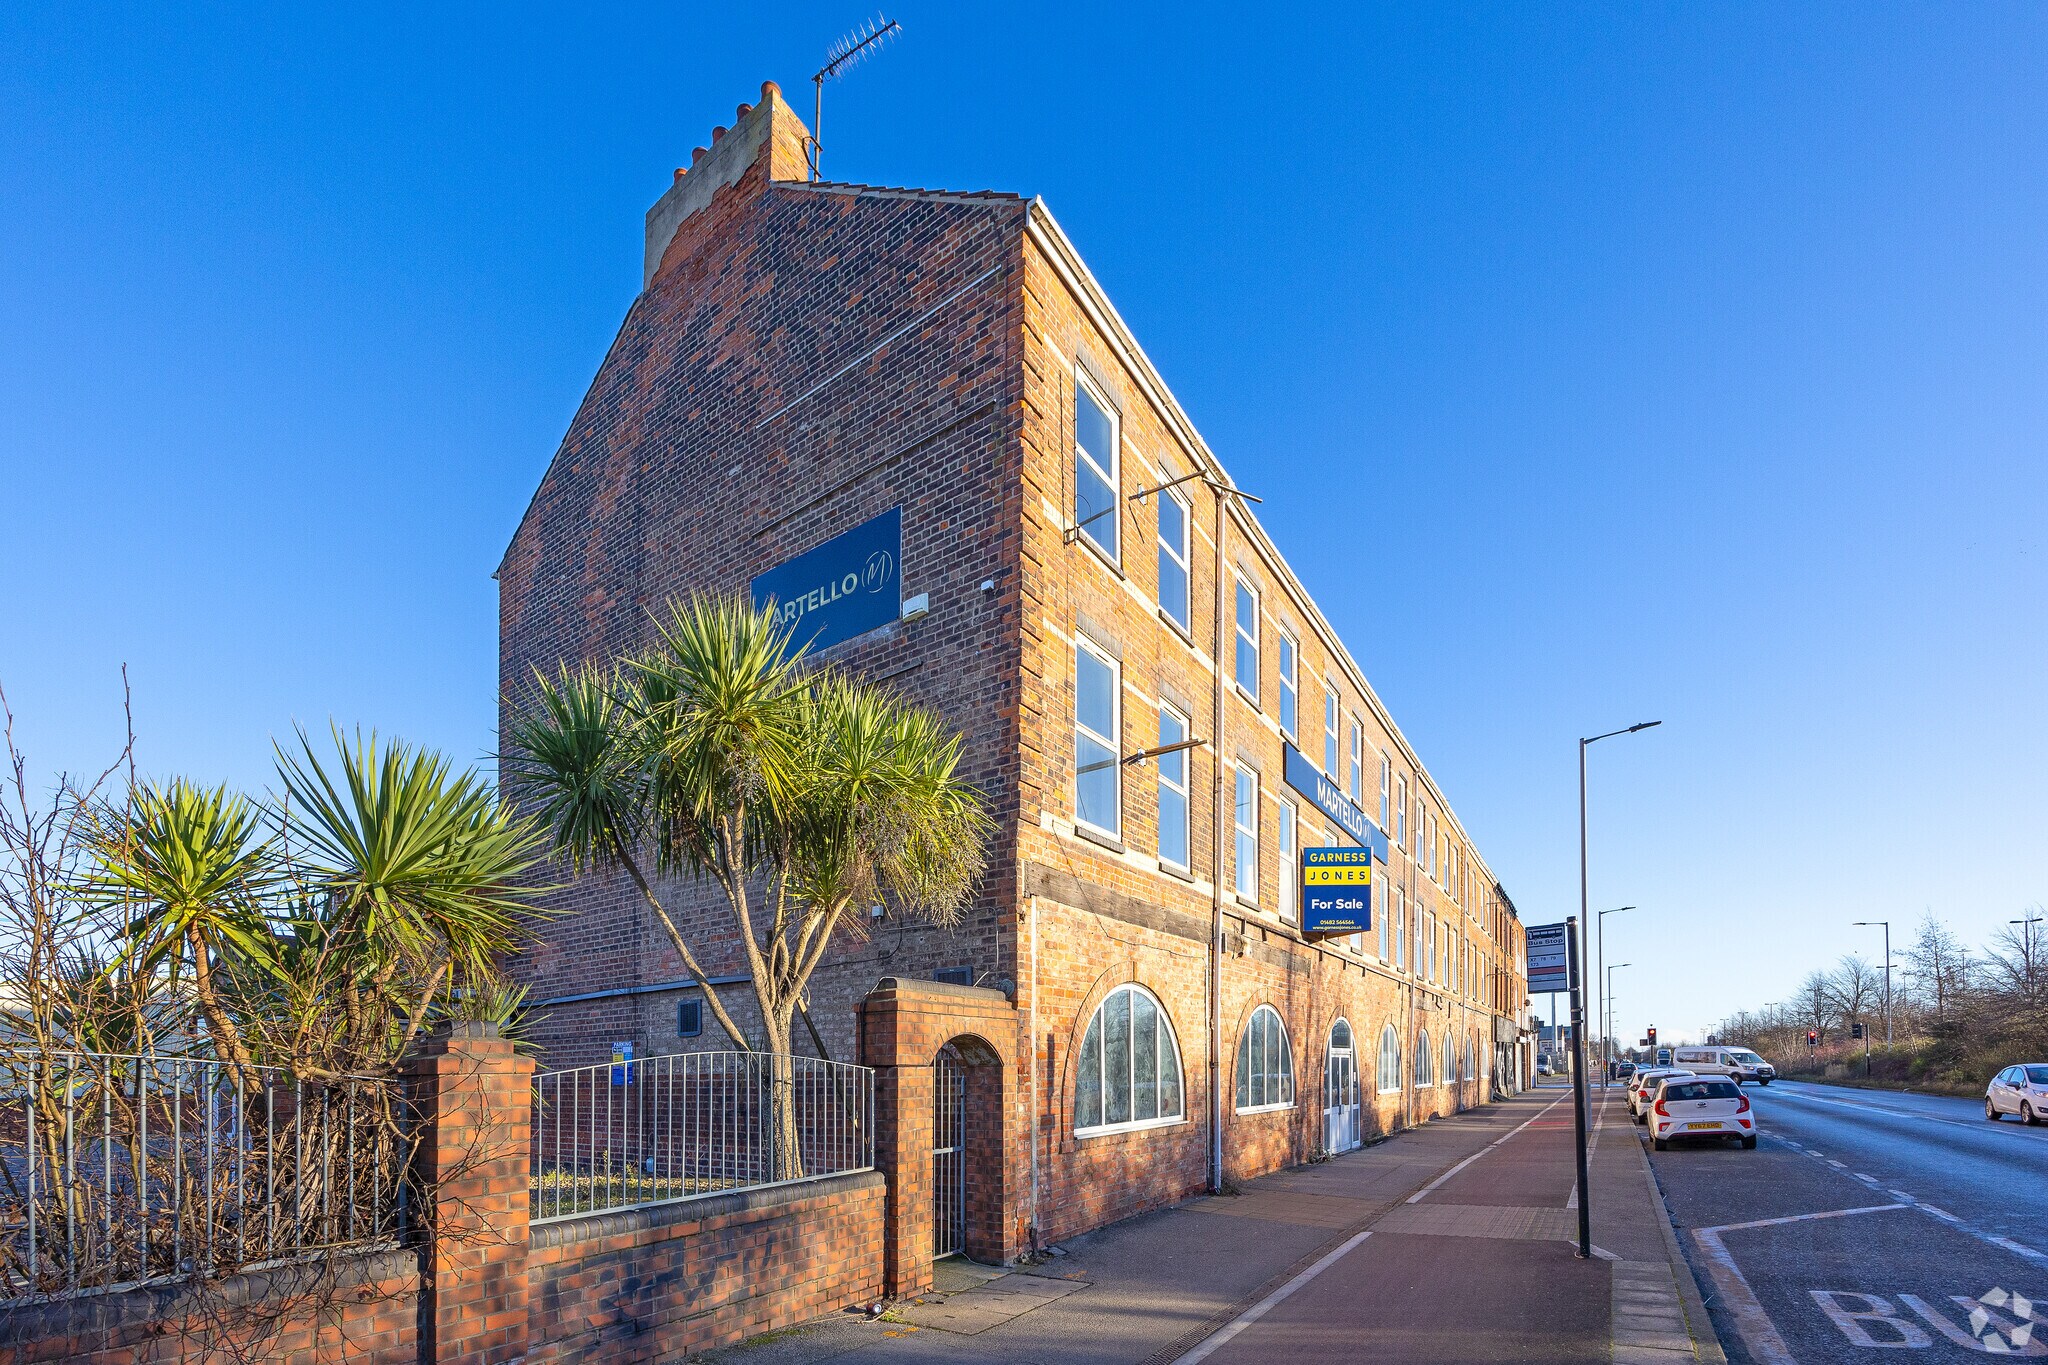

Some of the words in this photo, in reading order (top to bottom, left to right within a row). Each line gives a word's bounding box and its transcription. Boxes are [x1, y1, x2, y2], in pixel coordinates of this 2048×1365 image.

[769, 573, 858, 629] ARTELLO
[1317, 777, 1363, 837] MARTELLO
[1309, 852, 1366, 863] GARNESS
[1310, 871, 1366, 880] JONES
[1311, 898, 1333, 910] For
[1335, 898, 1364, 910] Sale
